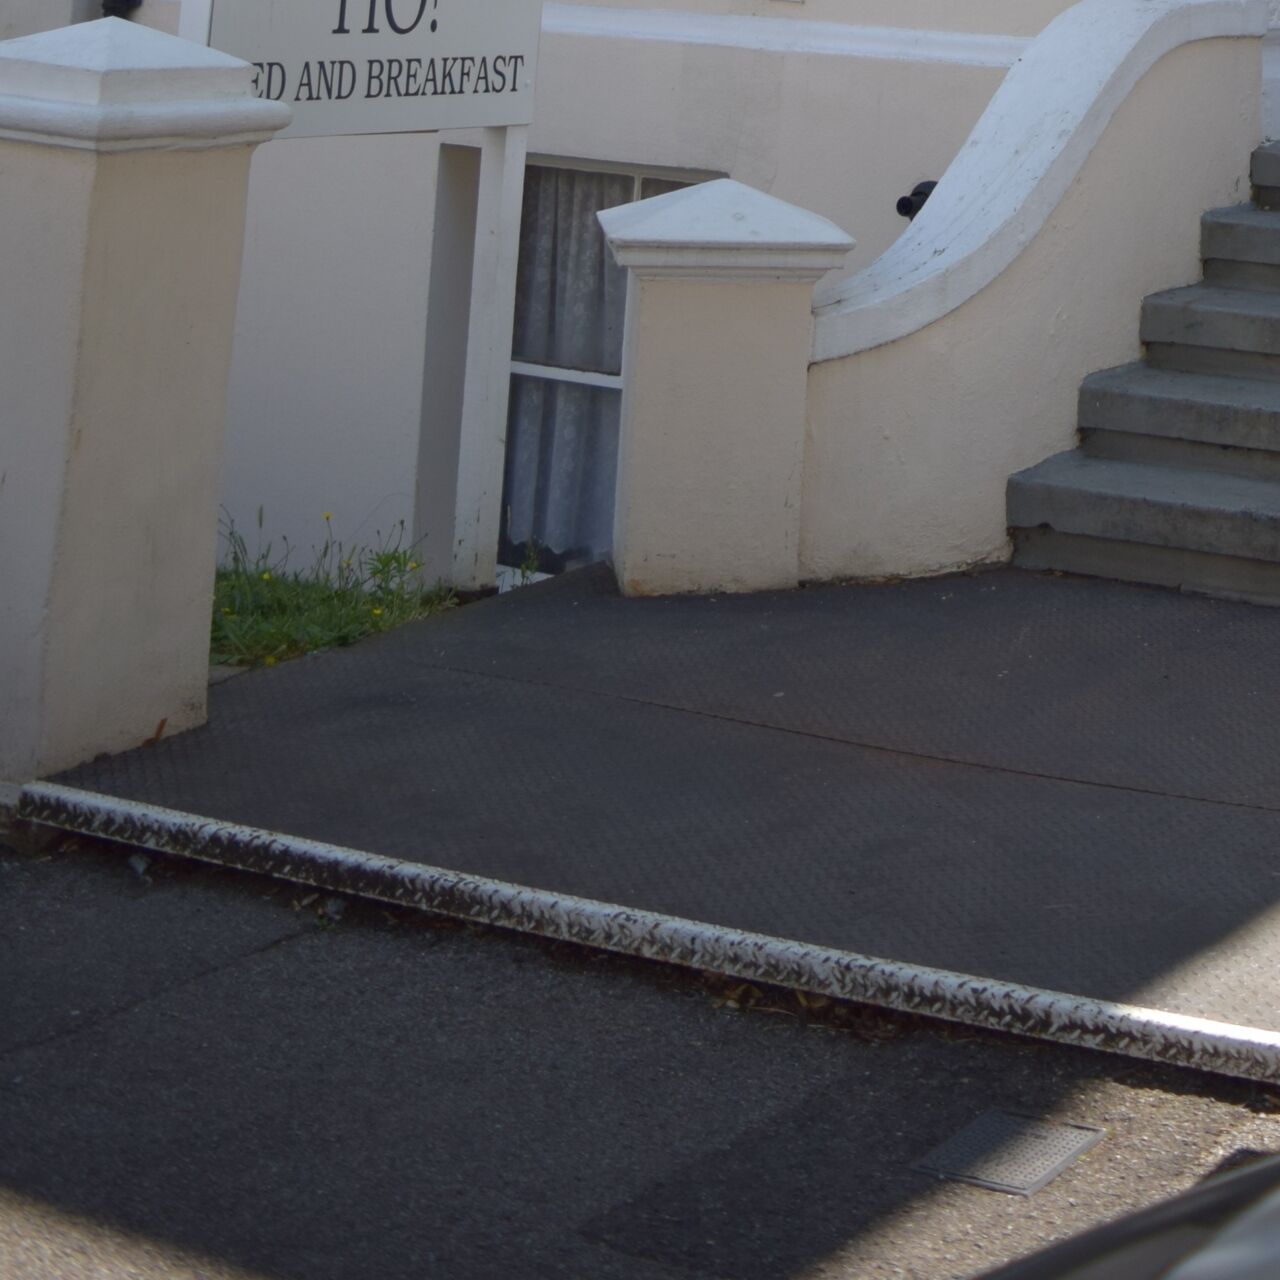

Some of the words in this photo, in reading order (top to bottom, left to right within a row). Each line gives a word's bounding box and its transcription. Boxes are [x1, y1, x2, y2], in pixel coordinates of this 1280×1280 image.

[251, 62, 287, 101] ED
[294, 60, 357, 102] AND
[364, 55, 525, 98] BREAKFAST
